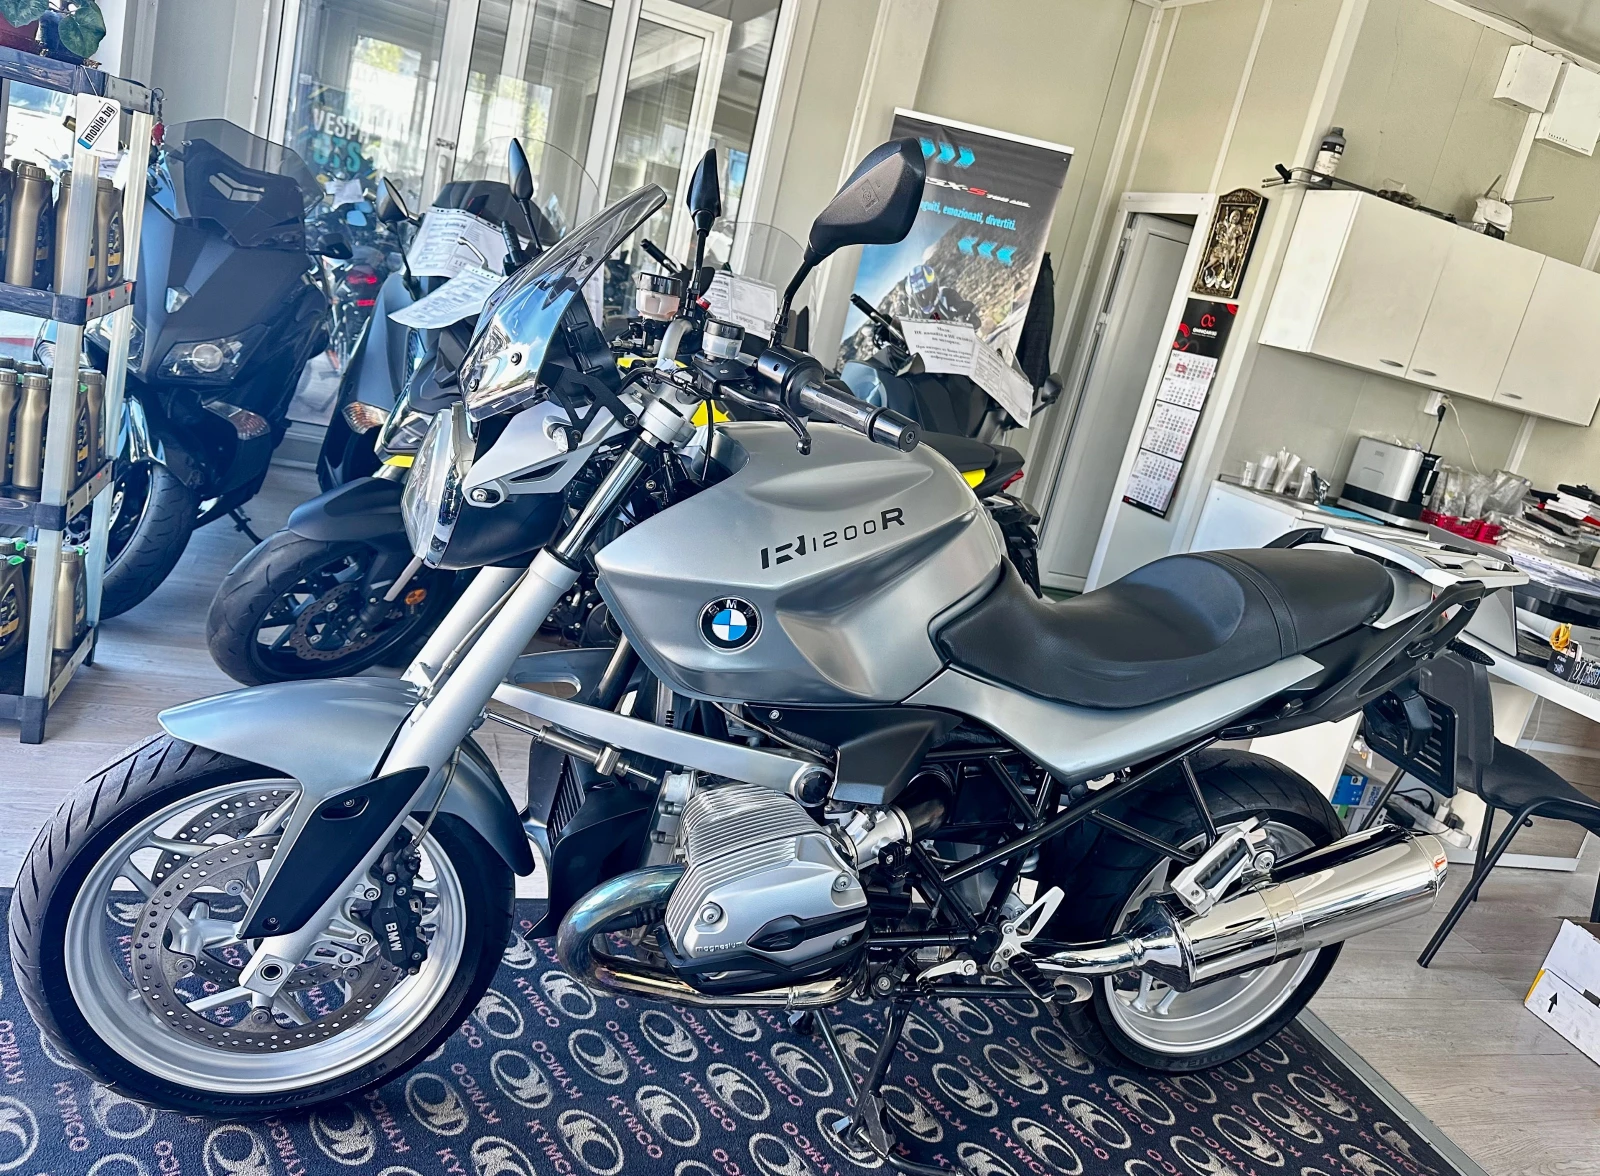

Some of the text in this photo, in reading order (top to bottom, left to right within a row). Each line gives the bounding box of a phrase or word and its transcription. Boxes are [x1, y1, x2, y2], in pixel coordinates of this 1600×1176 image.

[84, 105, 116, 143] mobile.bg
[943, 205, 984, 225] emozionati,
[985, 215, 1017, 231] divertiti.
[385, 922, 403, 951] BMW
[513, 976, 561, 1028] KYMCO
[531, 1040, 584, 1100] KYMCO
[605, 1020, 657, 1076] KYMCO
[1006, 1035, 1069, 1087] KYMCO
[451, 1062, 502, 1125] KYMCO
[679, 1071, 737, 1132] KYMCO
[745, 1050, 804, 1107] KYMCO
[904, 1074, 968, 1131] KYMCO
[958, 1054, 1021, 1108] KYMCO
[1303, 1065, 1374, 1113] KYMCO
[53, 1080, 90, 1152] KYMCO
[606, 1094, 663, 1160] KYMCO
[1041, 1103, 1110, 1161] KYMCO
[1088, 1082, 1156, 1135] KYMCO
[1230, 1104, 1303, 1157] KYMCO
[1268, 1083, 1340, 1135] KYMCO
